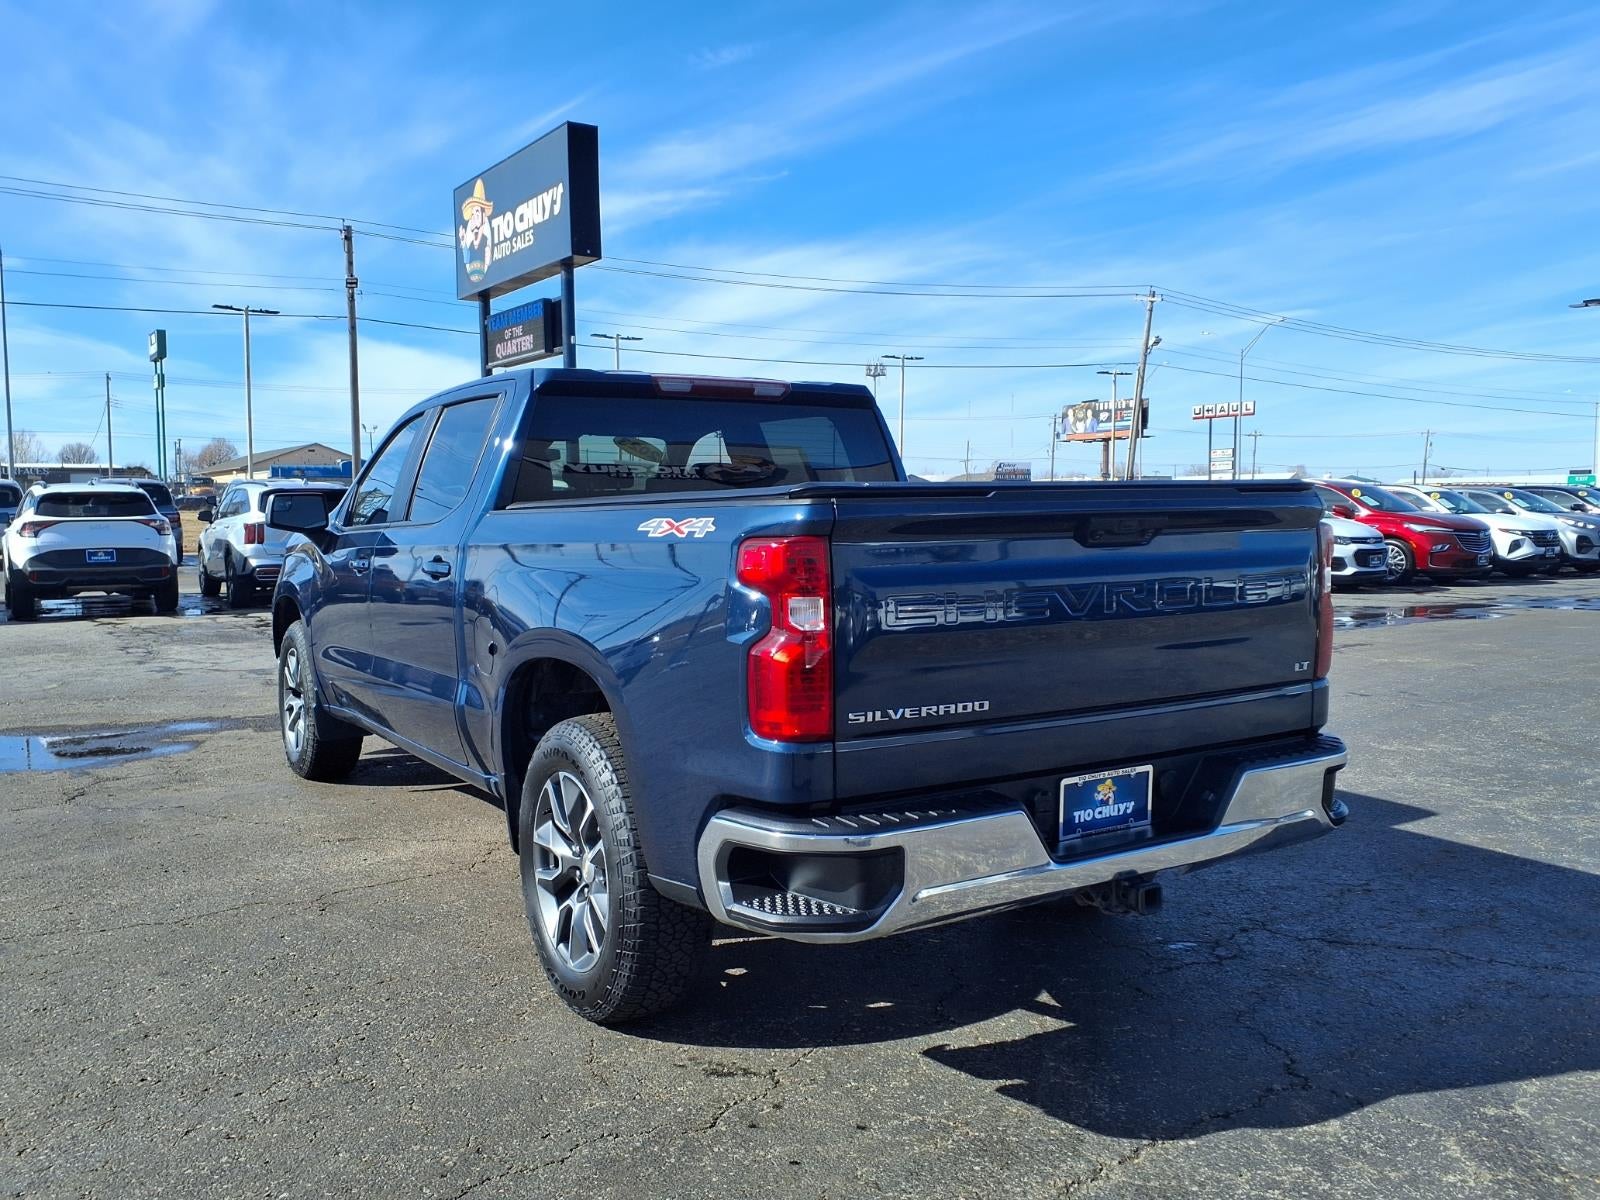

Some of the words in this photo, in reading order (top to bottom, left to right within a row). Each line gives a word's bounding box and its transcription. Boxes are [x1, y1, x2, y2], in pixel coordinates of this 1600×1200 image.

[491, 214, 515, 244] TIO
[515, 183, 563, 231] CHUY'S
[493, 236, 511, 261] AUTO
[512, 229, 534, 253] SALES
[511, 302, 544, 325] MEMBER
[504, 328, 511, 339] OF
[512, 325, 523, 338] THE
[495, 334, 534, 359] QUARTER!
[884, 573, 1307, 631] CHEVROLET
[1294, 661, 1310, 672] LT
[848, 700, 990, 724] SILVERADO
[1073, 808, 1093, 824] TIO
[1094, 801, 1135, 819] CHUY'S
